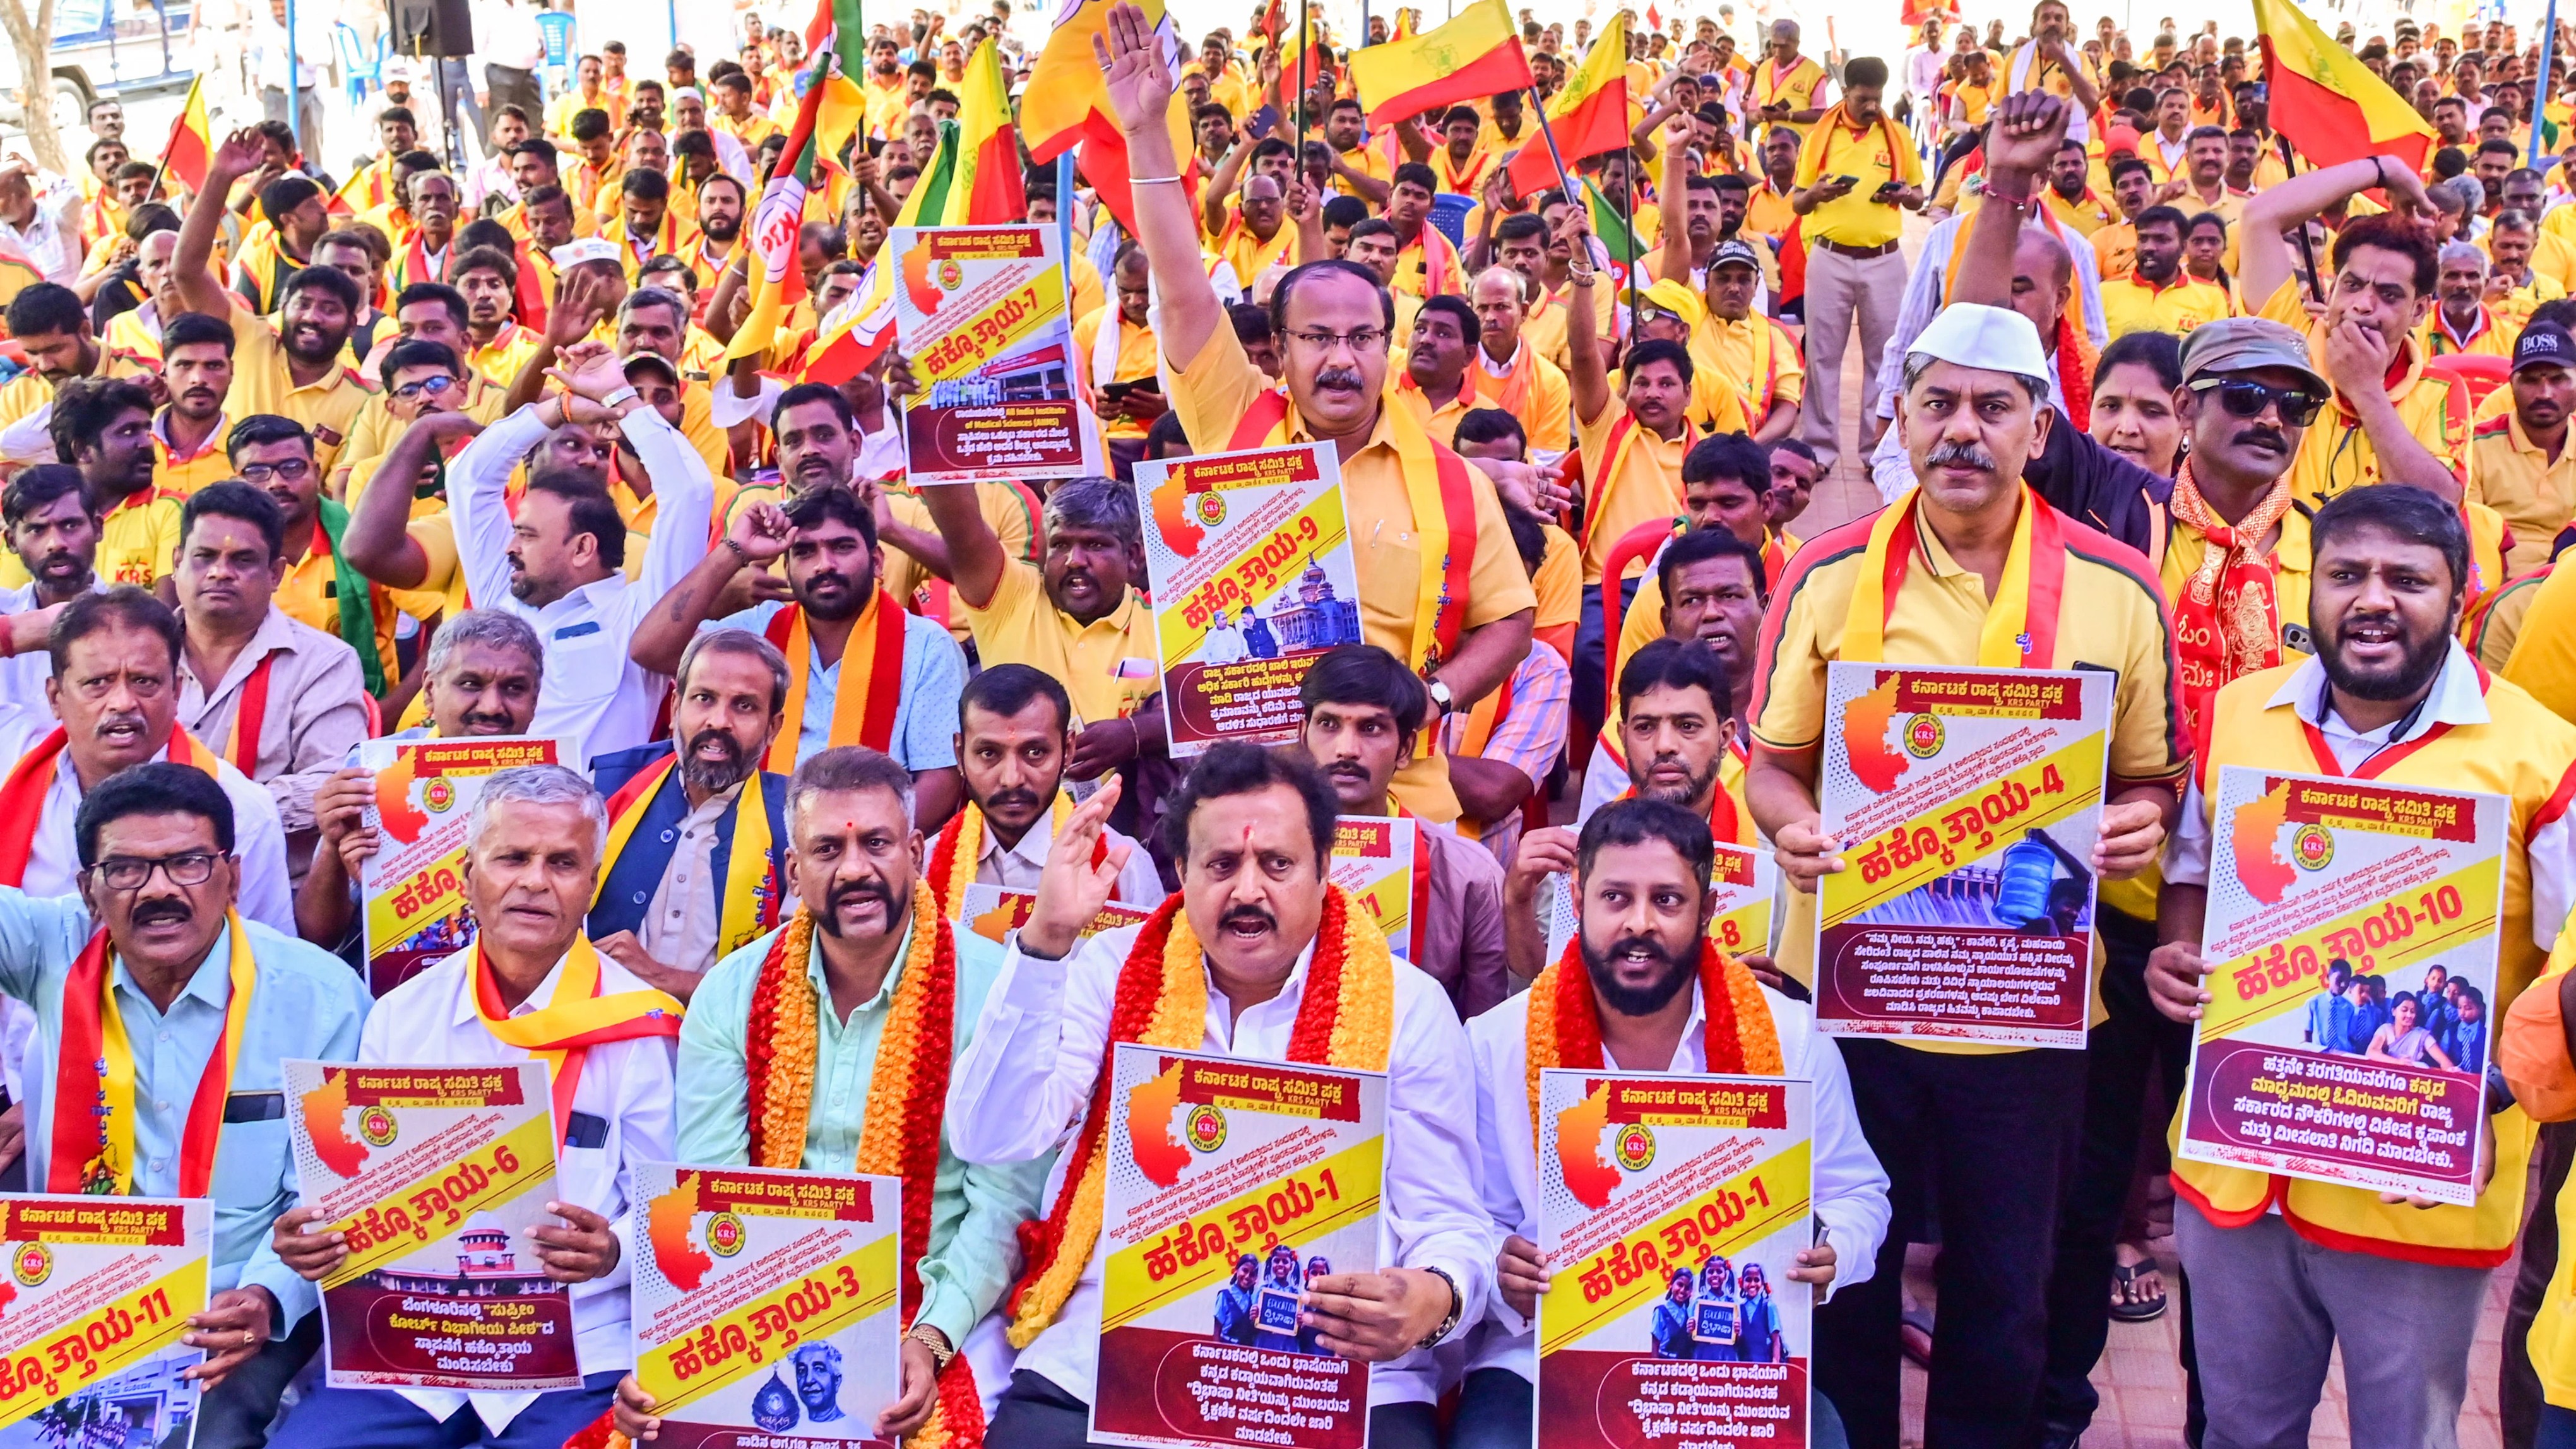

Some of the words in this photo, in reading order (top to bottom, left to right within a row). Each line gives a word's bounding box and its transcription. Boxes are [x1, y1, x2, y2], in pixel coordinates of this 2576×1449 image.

[925, 288, 1037, 374] ಹಕ್ಕೊತ್ತಾಯ-7
[2522, 333, 2558, 348] BOSS
[1194, 463, 1233, 477] ಕರ್ನಾಟಕ
[1236, 460, 1262, 480] ರಾಷ್ಟ್ರ
[1259, 457, 1285, 470] ಸಮಿತಿ
[1287, 455, 1303, 472] ಪಕ್ಷ
[1264, 469, 1278, 477] KRS
[1277, 468, 1295, 476] PARTY
[1204, 504, 1218, 512] KRS
[114, 569, 153, 584] KRS
[1182, 516, 1317, 628] ಹಕ್ಕೊತ್ತಾಯ-9
[2178, 613, 2211, 647] ಓಂ
[1911, 679, 1968, 695] ಕರ್ನಾಟಕ
[1969, 682, 2003, 707] ರಾಷ್ಟ್ರ
[2003, 683, 2038, 698] ಸಮಿತಿ
[2041, 684, 2063, 705] ಪಕ್ಷ
[2007, 699, 2024, 707] KRS
[2025, 699, 2050, 708] PARTY
[1914, 730, 1933, 740] KRS
[2301, 789, 2358, 808] ಕರ್ನಾಟಕ
[2359, 797, 2395, 823] ರಾಷ್ಟ್ರ
[2394, 799, 2430, 816] ಸಮಿತಿ
[2433, 803, 2456, 825] ಪಕ್ಷ
[1858, 764, 2064, 884] ಹಕ್ಕೊತ್ತಾಯ-4
[2398, 815, 2416, 825] KRS
[2416, 817, 2443, 827] PARTY
[1360, 828, 1377, 845] ಪಕ್ಷ
[2303, 841, 2323, 851] KRS
[2233, 885, 2462, 998] ಹಕ್ಕೊತ್ತಾಯ-10
[358, 1075, 410, 1089] ಕರ್ನಾಟಕ
[413, 1076, 446, 1097] ರಾಷ್ಟ್ರ
[444, 1076, 478, 1089] ಸಮಿತಿ
[482, 1075, 503, 1094] ಪಕ್ಷ
[1194, 1068, 1249, 1088] ಕರ್ನಾಟಕ
[1251, 1077, 1285, 1103] ರಾಷ್ಟ್ರ
[1283, 1079, 1317, 1096] ಸಮಿತಿ
[1321, 1084, 1341, 1104] ಪಕ್ಷ
[2263, 1056, 2303, 1079] ಹತ್ತನೇ
[2306, 1062, 2406, 1090] ತರಗತಿಯವರೆಗೂ
[2409, 1077, 2445, 1102] ಕನ್ನಡ
[1288, 1095, 1304, 1105] KRS
[1305, 1097, 1329, 1107] PARTY
[1621, 1088, 1675, 1104] ಕರ್ನಾಟಕ
[1678, 1091, 1711, 1116] ರಾಷ್ಟ್ರ
[1709, 1091, 1744, 1106] ಸಮಿತಿ
[1747, 1092, 1767, 1113] ಪಕ್ಷ
[1714, 1107, 1731, 1116] KRS
[1731, 1107, 1756, 1116] PARTY
[2252, 1077, 2330, 1109] ಮಾಧ್ಯಮದಲ್ಲಿ
[2420, 1104, 2452, 1128] ರಾಜ್ಯ
[1197, 1123, 1216, 1133] KRS
[2234, 1096, 2293, 1118] ಸರ್ಕಾರದ
[2369, 1117, 2412, 1138] ವಿಶೇಷ
[1626, 1142, 1644, 1150] KRS
[2240, 1120, 2271, 1144] ಮತ್ತು
[2340, 1135, 2374, 1154] ನಿಗದಿ
[343, 1145, 519, 1253] ಹಕ್ಕೊತ್ತಾಯ-6
[711, 1179, 764, 1195] ಕರ್ನಾಟಕ
[767, 1183, 799, 1207] ರಾಷ್ಟ್ರ
[798, 1185, 831, 1199] ಸಮಿತಿ
[834, 1186, 855, 1206] ಪಕ್ಷ
[803, 1199, 819, 1209] KRS
[819, 1200, 843, 1209] PARTY
[20, 1207, 74, 1222] ಕರ್ನಾಟಕ
[77, 1210, 110, 1234] ರಾಷ್ಟ್ರ
[109, 1210, 143, 1225] ಸಮಿತಿ
[146, 1212, 167, 1232] ಪಕ್ಷ
[113, 1226, 129, 1234] KRS
[130, 1226, 155, 1234] PARTY
[716, 1229, 735, 1238] KRS
[1143, 1168, 1339, 1281] ಹಕ್ಕೊತ್ತಾಯ-1
[1578, 1176, 1769, 1303] ಹಕ್ಕೊತ್ತಾಯ-1
[669, 1265, 859, 1380] ಹಕ್ಕೊತ್ತಾಯ-3
[0, 1287, 171, 1400] ಕ್ಕೊತ್ತಾಯ-11
[1193, 1344, 1258, 1368] ಕರ್ನಾಟಕದಲ್ಲಿ
[1260, 1354, 1290, 1368] ಒಂದು
[1293, 1357, 1348, 1373] ಭಾಷೆಯಾಗಿ
[1632, 1362, 1698, 1381] ಕರ್ನಾಟಕದಲ್ಲಿ
[1699, 1364, 1730, 1378] ಒಂದು
[1732, 1364, 1787, 1381] ಭಾಷೆಯಾಗಿ
[1200, 1364, 1228, 1384] ಕನ್ನಡ
[1231, 1368, 1338, 1392] ಕಡ್ಡಾಯವಾಗಿರುವಂತಹ
[1292, 1395, 1349, 1412] ಮುಂಬರುವ
[1640, 1381, 1668, 1400] ಕನ್ನಡ
[1671, 1383, 1778, 1403] ಕಡ್ಡಾಯವಾಗಿರುವಂತಹ
[1200, 1399, 1236, 1421] ಶೈಕ್ಷಣಿಕ
[1238, 1407, 1305, 1426] ವರ್ಷದಿಂದಲೇ
[1309, 1416, 1333, 1429] ಜಾರಿ
[1733, 1404, 1790, 1419] ಮುಂಬರುವ
[1642, 1417, 1678, 1438] ಶೈಕ್ಷಣಿಕ
[1680, 1421, 1748, 1436] ವರ್ಷದಿಂದಲೇ
[1750, 1423, 1774, 1438] ಜಾರಿ
